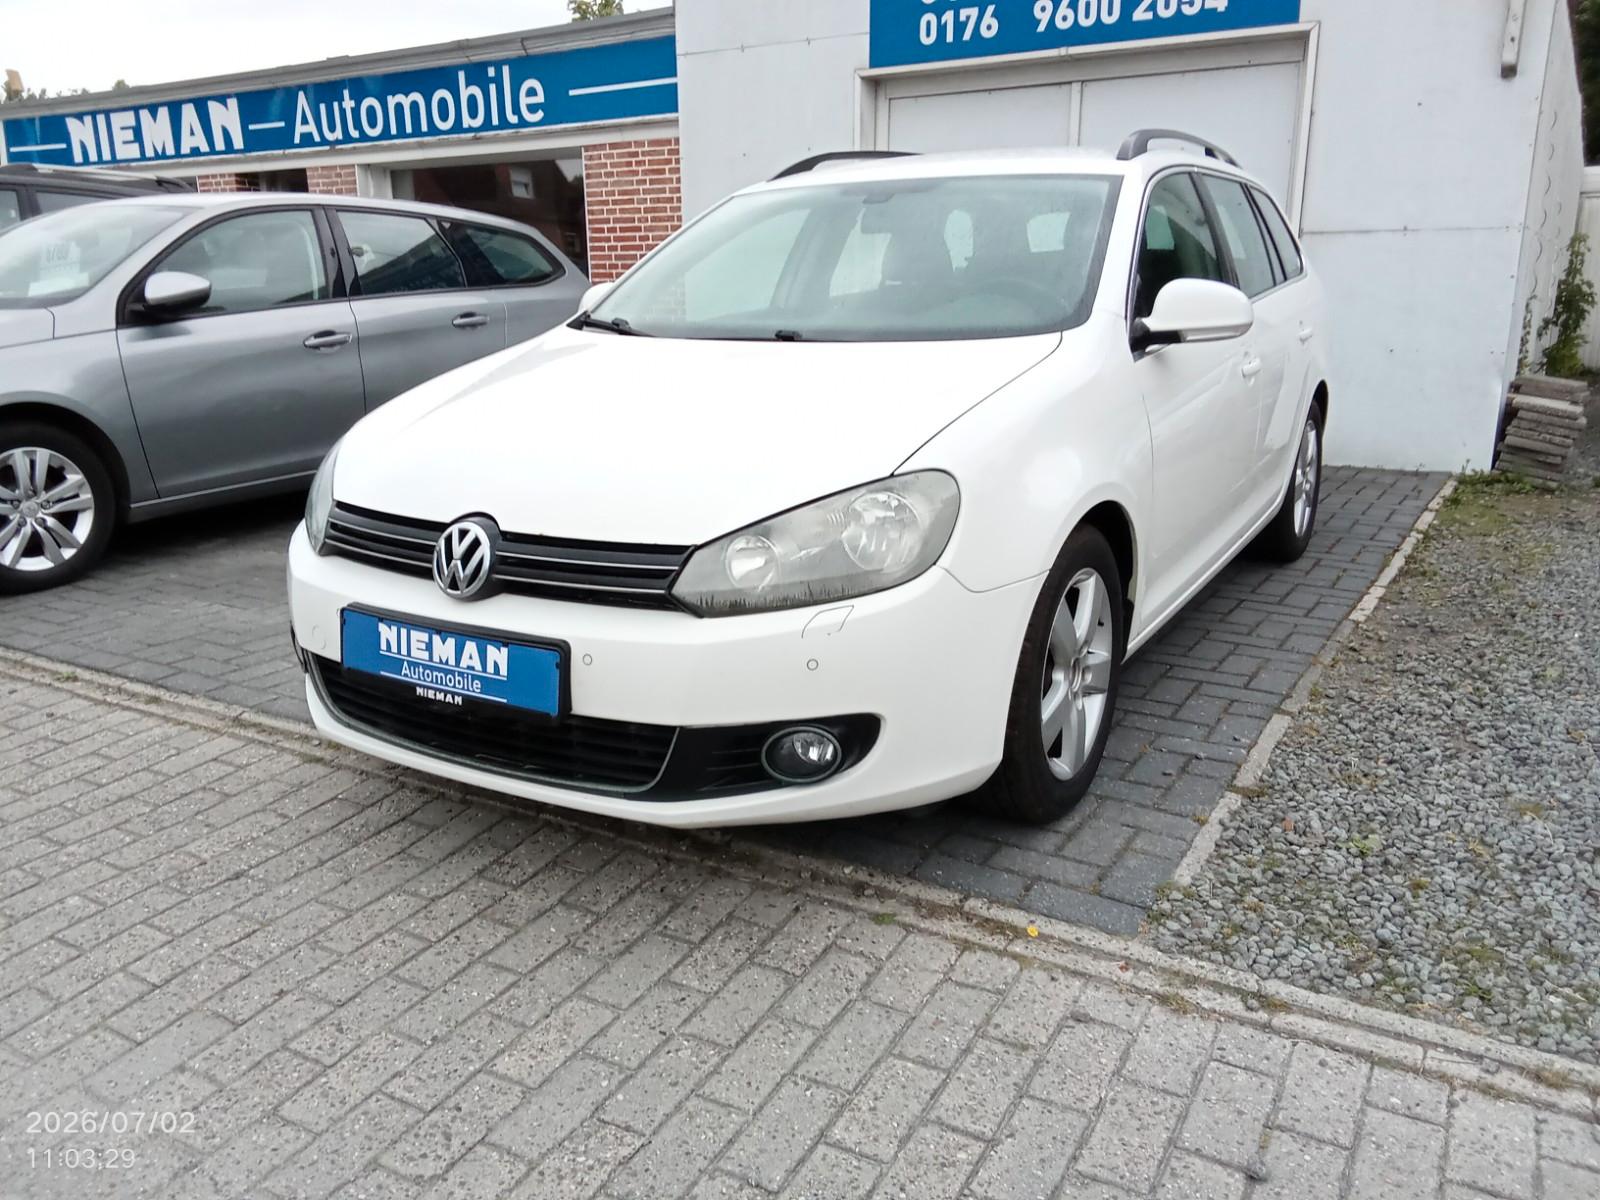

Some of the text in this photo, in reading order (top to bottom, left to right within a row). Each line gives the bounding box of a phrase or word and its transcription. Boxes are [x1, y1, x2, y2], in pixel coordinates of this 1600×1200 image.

[919, 4, 999, 46] 0176
[1033, 0, 1121, 33] 9600
[64, 65, 546, 164] NIEMAN Automobile
[378, 621, 509, 677] NIEMAN
[400, 661, 482, 693] Automobile
[416, 686, 463, 706] NIEMAN
